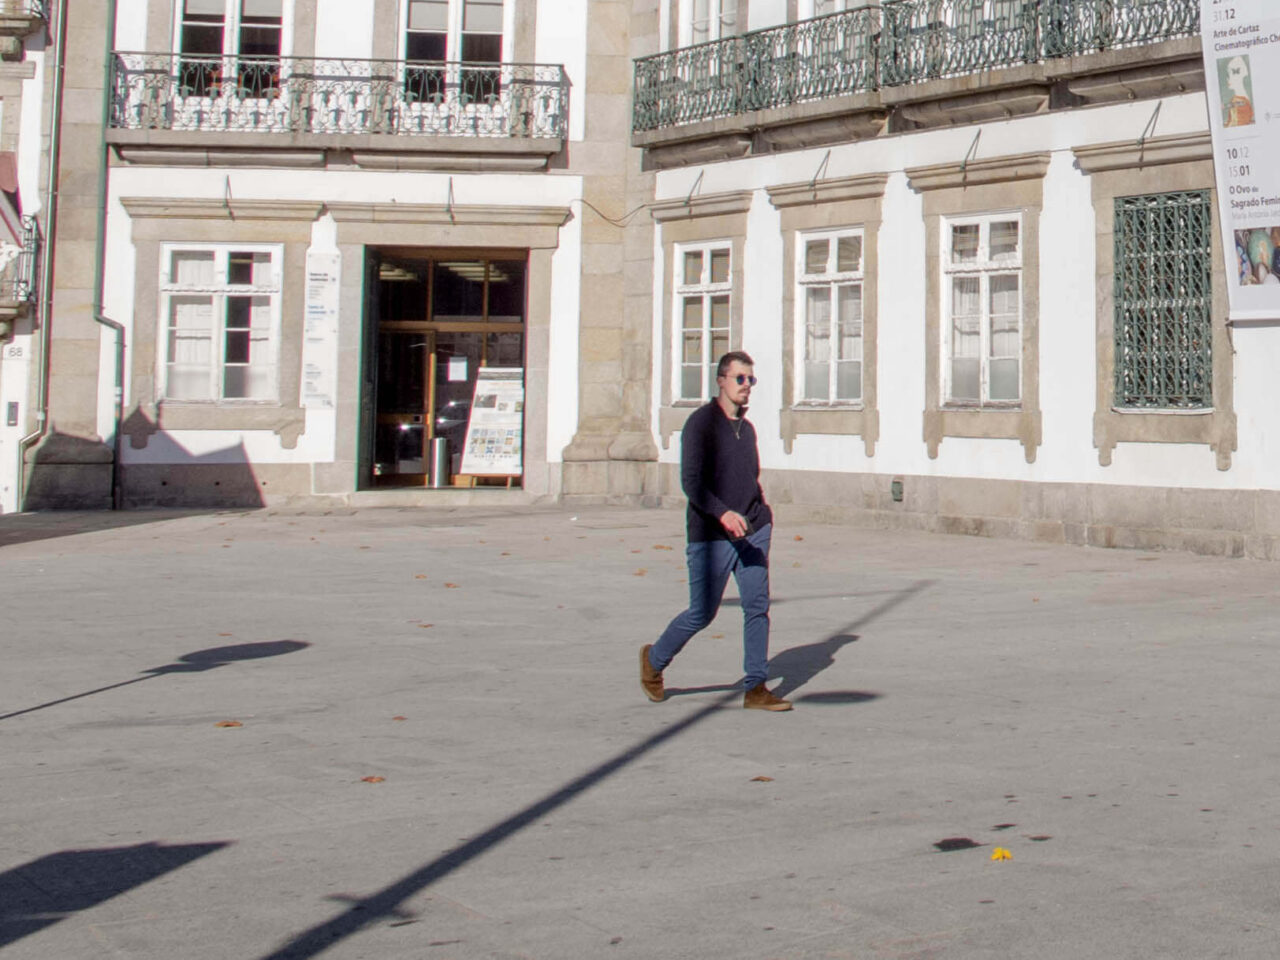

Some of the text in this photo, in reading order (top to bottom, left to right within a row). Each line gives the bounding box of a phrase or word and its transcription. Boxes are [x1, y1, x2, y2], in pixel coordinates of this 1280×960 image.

[1213, 24, 1260, 39] Arte de Cartaz
[1229, 186, 1235, 195] O
[1236, 185, 1251, 195] Ovo
[1231, 197, 1260, 210] Sagrado
